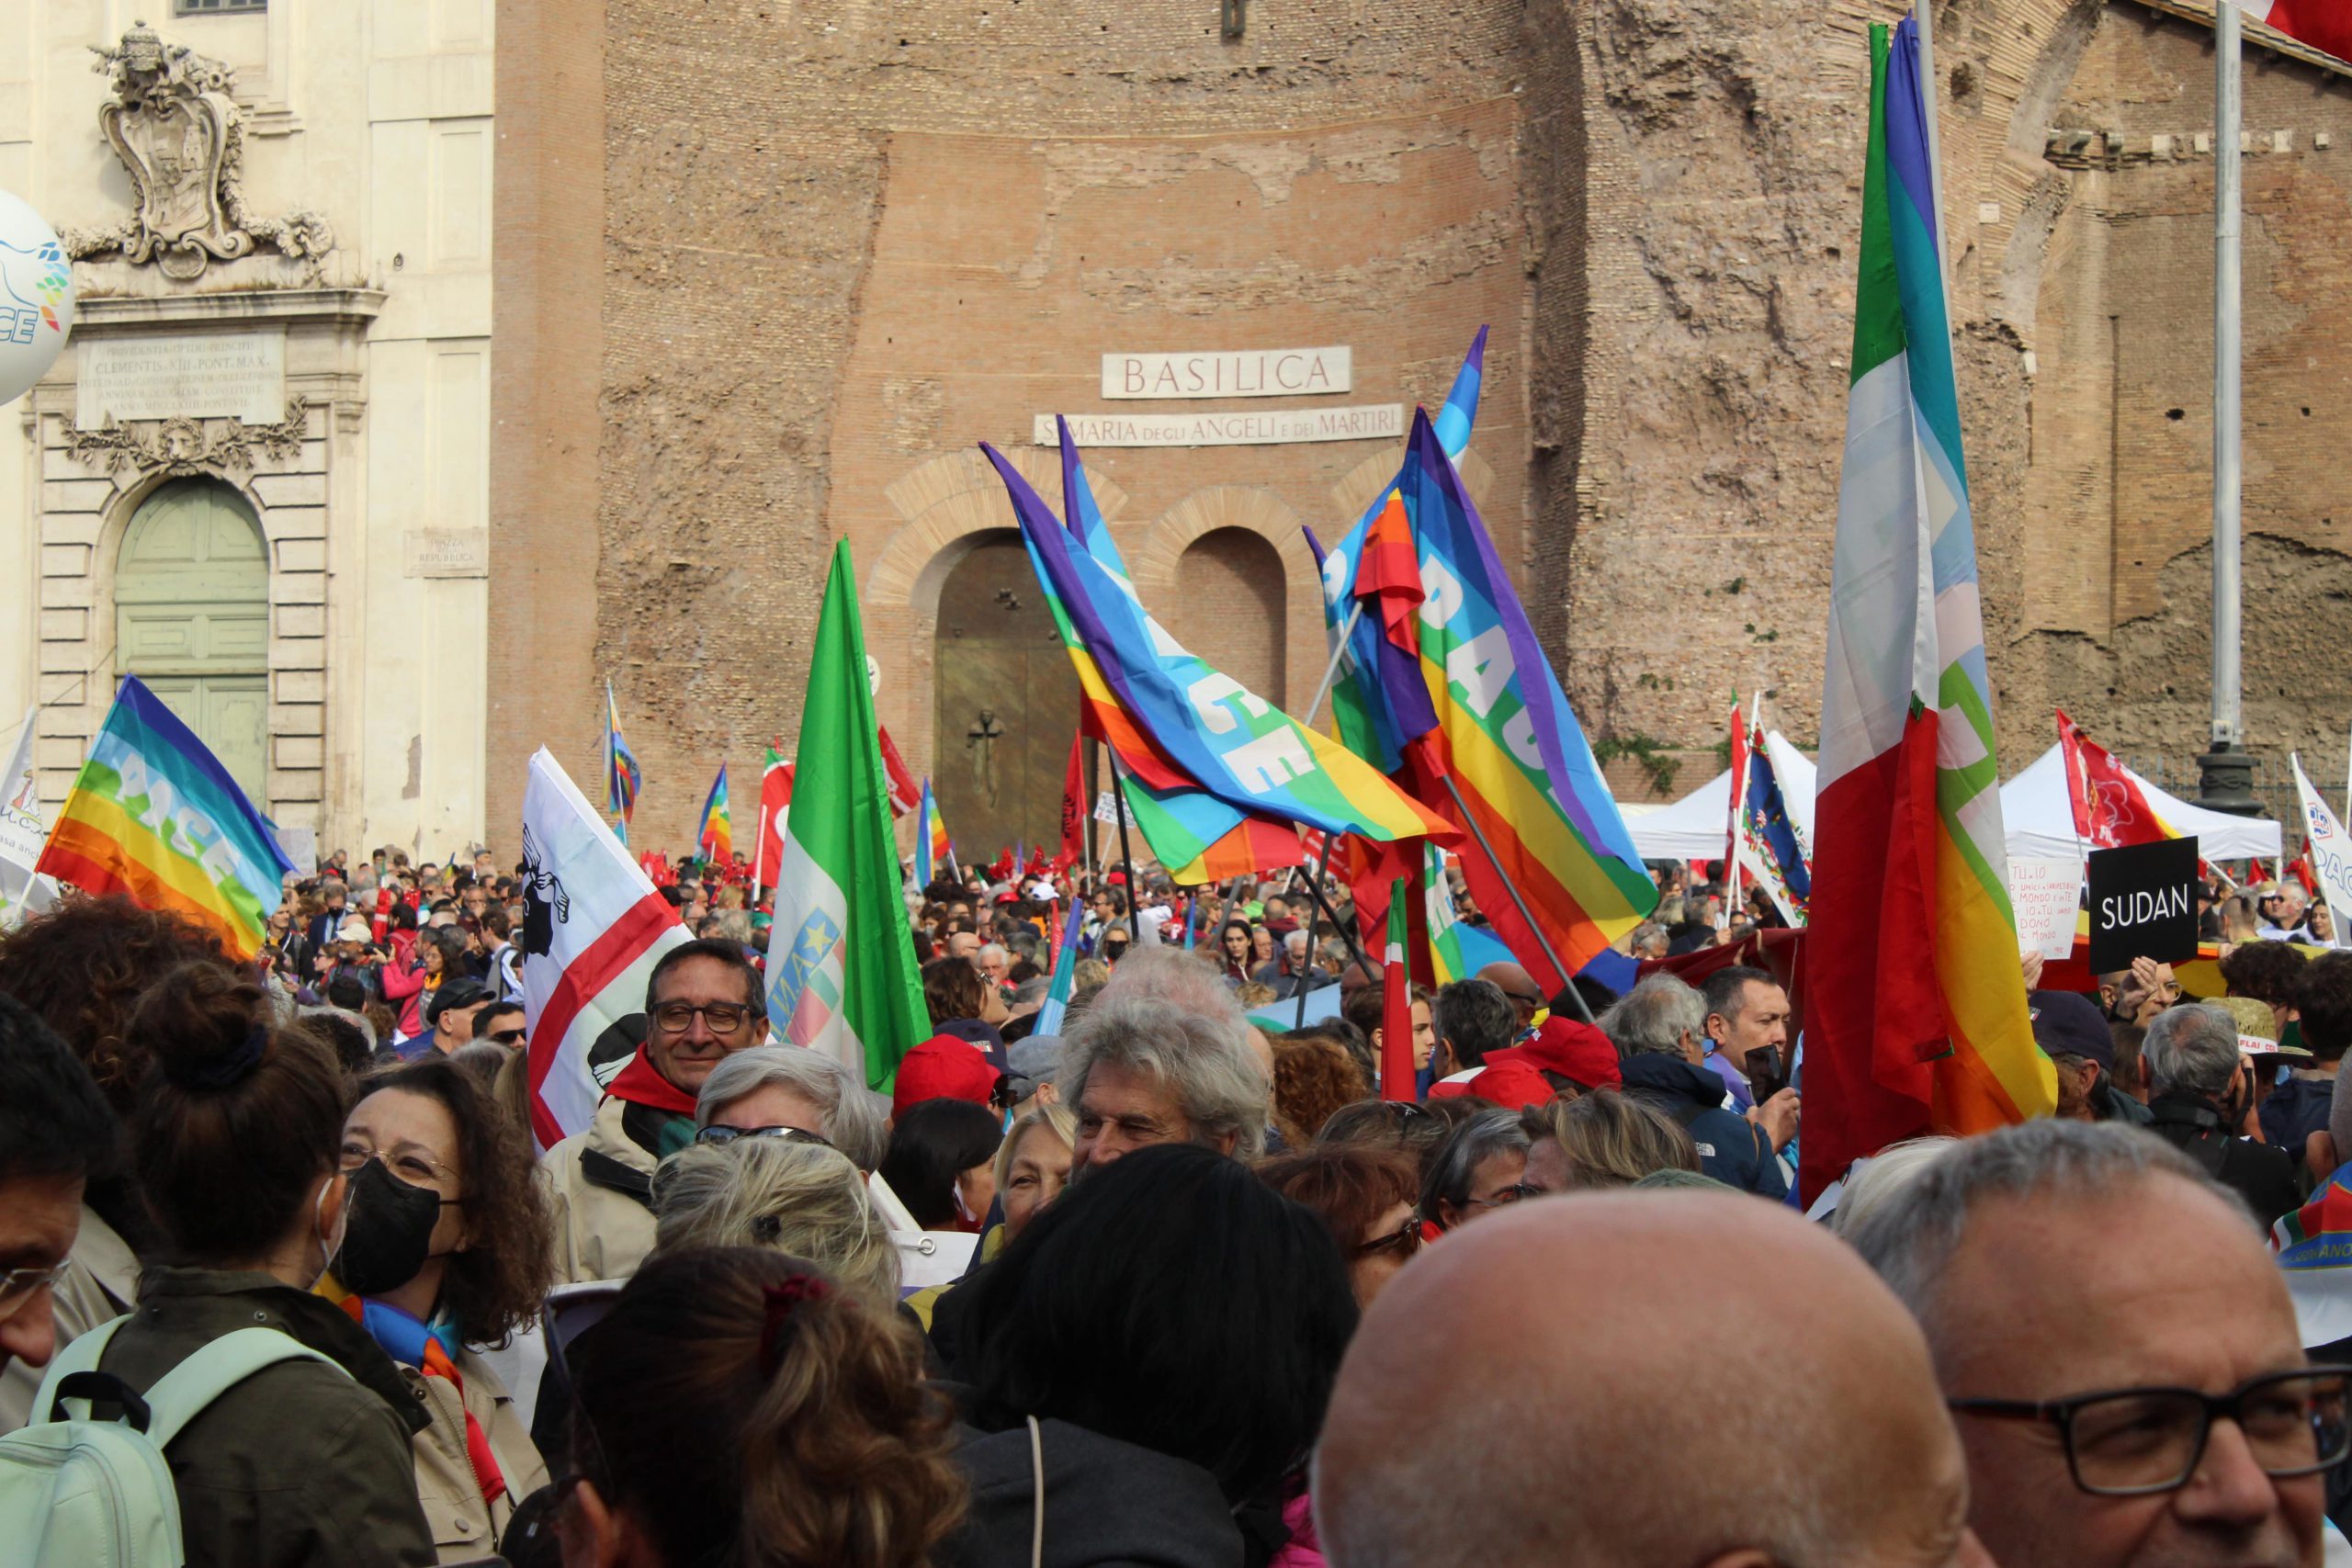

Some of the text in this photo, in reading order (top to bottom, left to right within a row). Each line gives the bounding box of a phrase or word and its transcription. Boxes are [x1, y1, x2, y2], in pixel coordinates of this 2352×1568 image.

[1125, 355, 1330, 393] BASILICA
[1069, 420, 1137, 442] MARIA
[1143, 425, 1185, 441] DEGLI
[1192, 416, 1275, 440] ANGELI
[1281, 423, 1287, 436] E
[1294, 422, 1314, 435] DEI
[1319, 408, 1396, 434] MARTIRI
[111, 751, 242, 888] PACE
[2019, 893, 2051, 903] MONDO
[2101, 883, 2188, 930] SUDAN
[2020, 918, 2051, 930] DONO
[2239, 1039, 2260, 1050] FLAI
